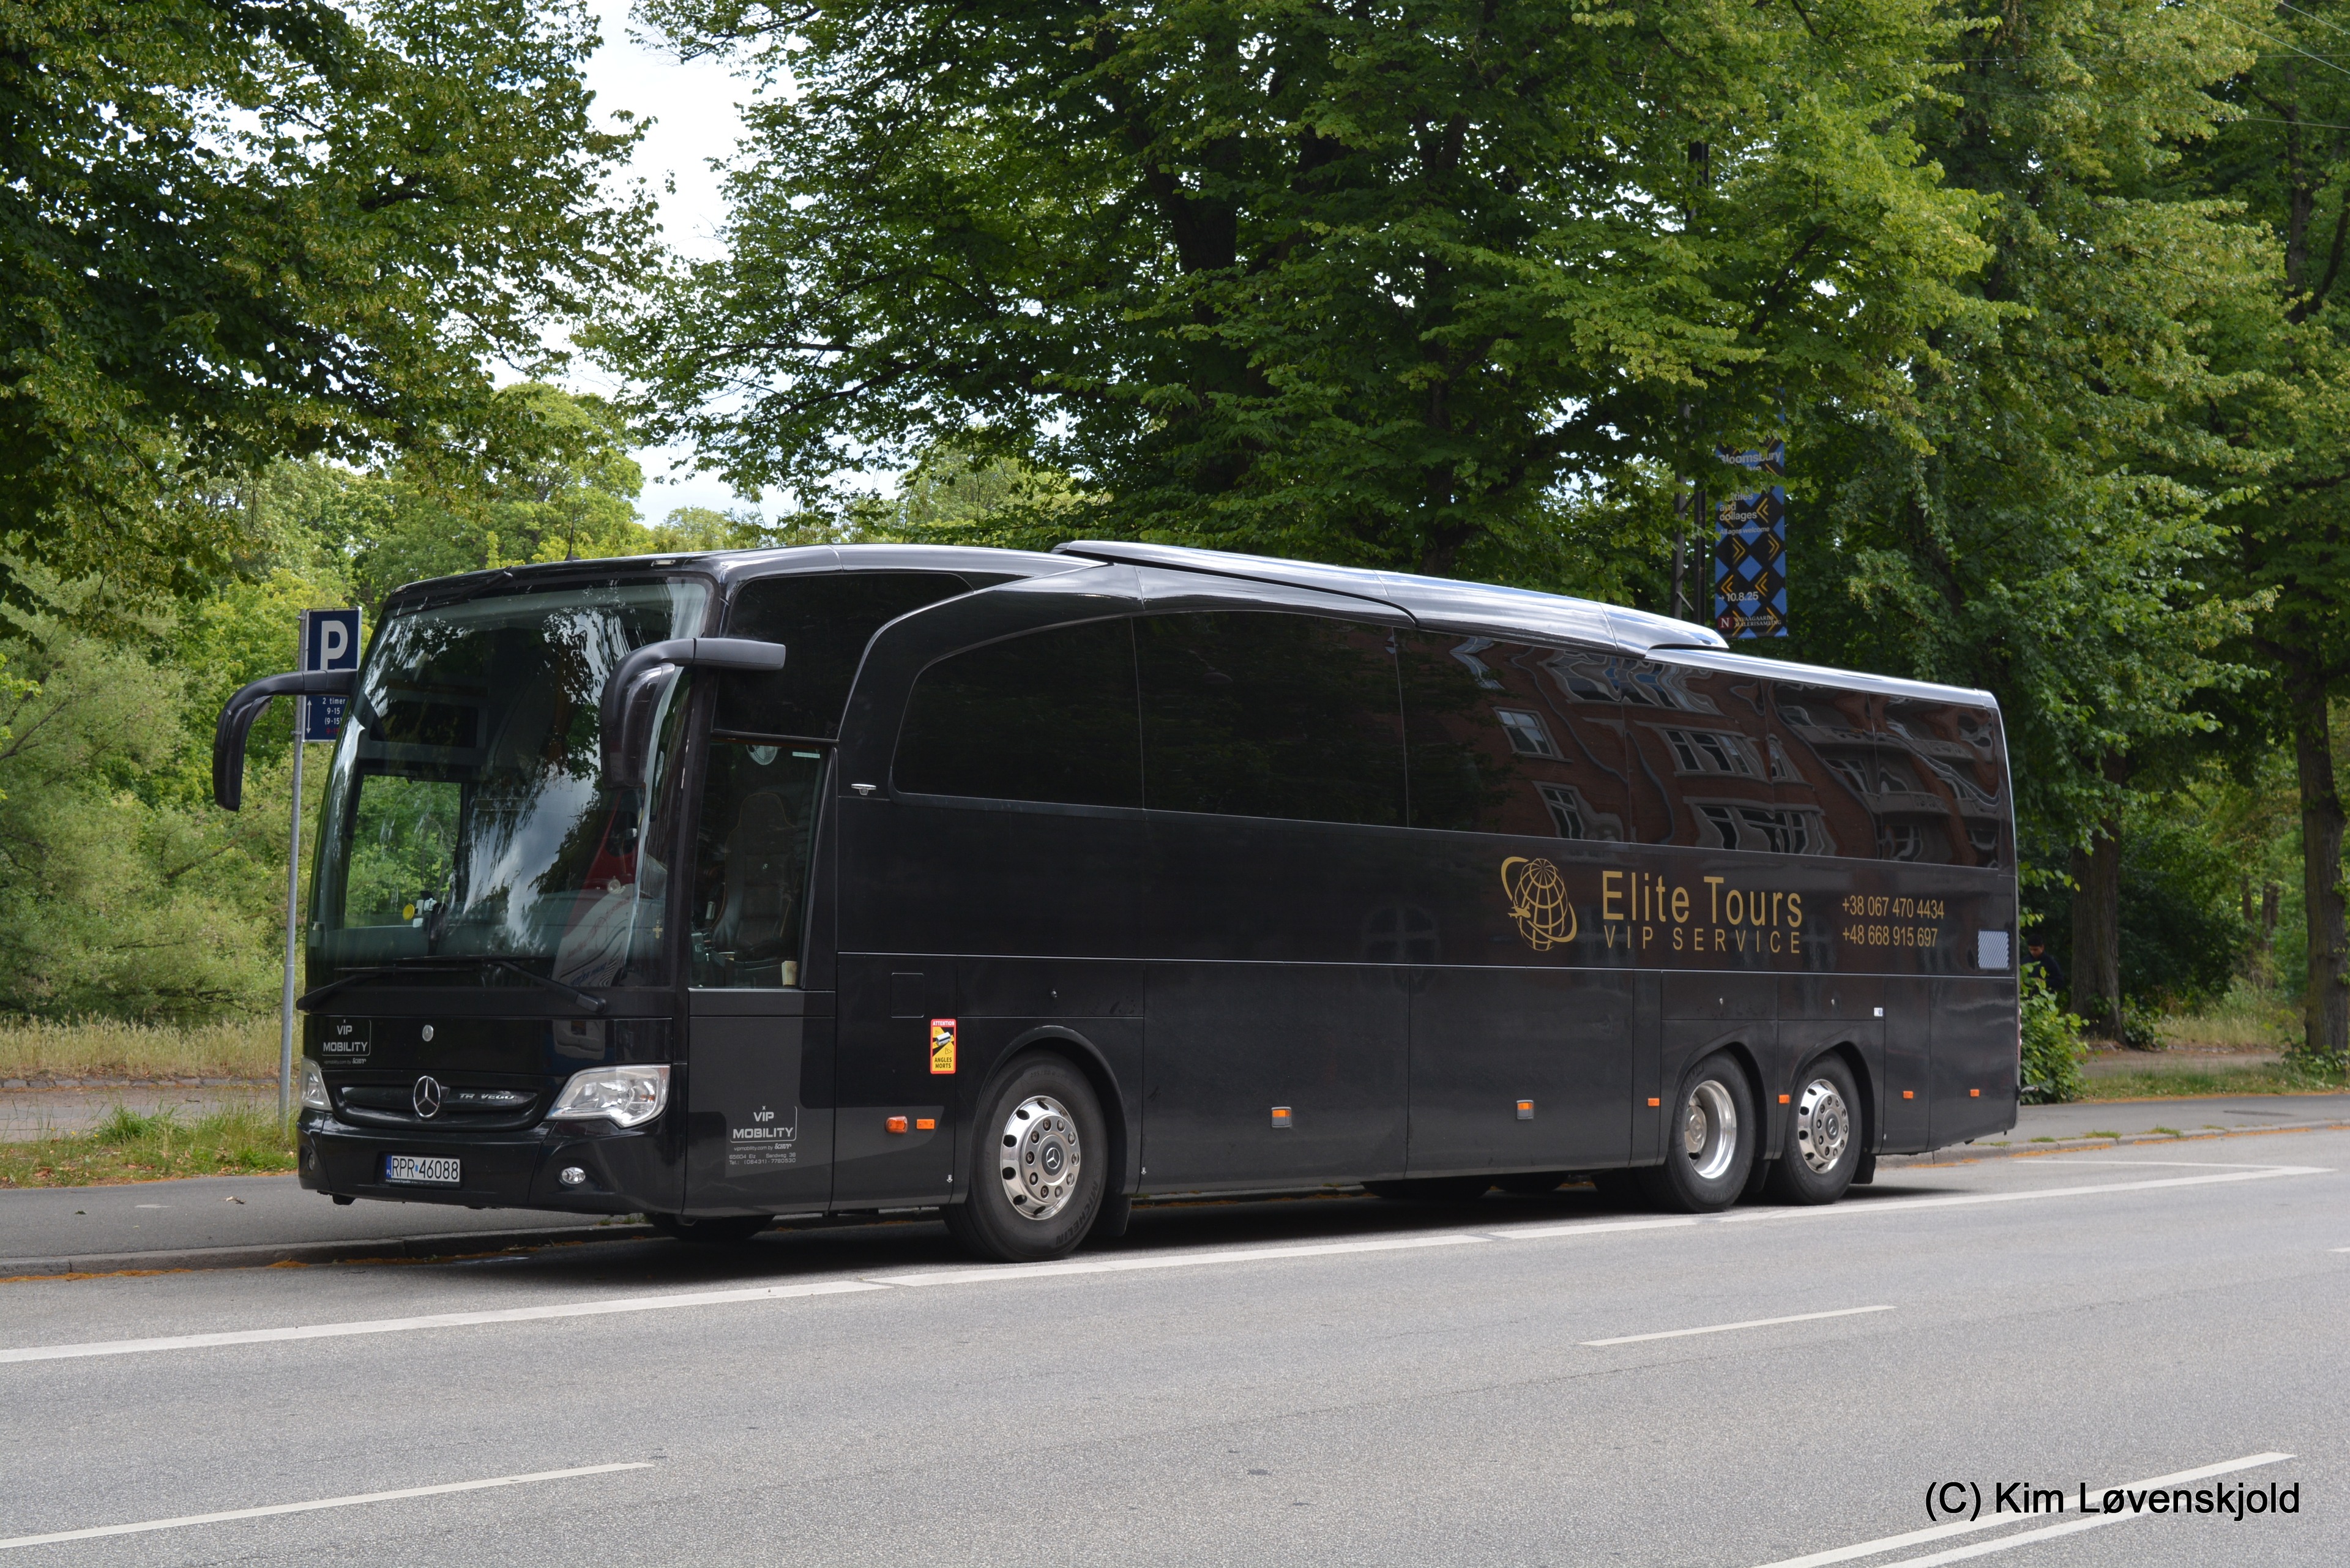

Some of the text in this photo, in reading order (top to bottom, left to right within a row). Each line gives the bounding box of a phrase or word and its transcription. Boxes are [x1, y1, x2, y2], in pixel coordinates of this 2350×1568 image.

[1720, 512, 1757, 521] collages
[1726, 591, 1759, 602] 10.8.25
[1720, 618, 1730, 627] N
[320, 620, 348, 670] P
[1602, 870, 1802, 927] Elite Tours
[1842, 895, 1944, 919] +38 067 470 4434
[1604, 925, 1800, 954] VIP SERVICE
[1843, 924, 1938, 947] +48 668 915 697
[337, 1025, 352, 1035] VIP
[323, 1042, 368, 1051] MOBILITY
[753, 1111, 774, 1122] VIP
[733, 1127, 794, 1138] MOBILITY
[392, 1157, 458, 1180] RPR 46088
[1055, 1179, 1099, 1246] MICHELIN
